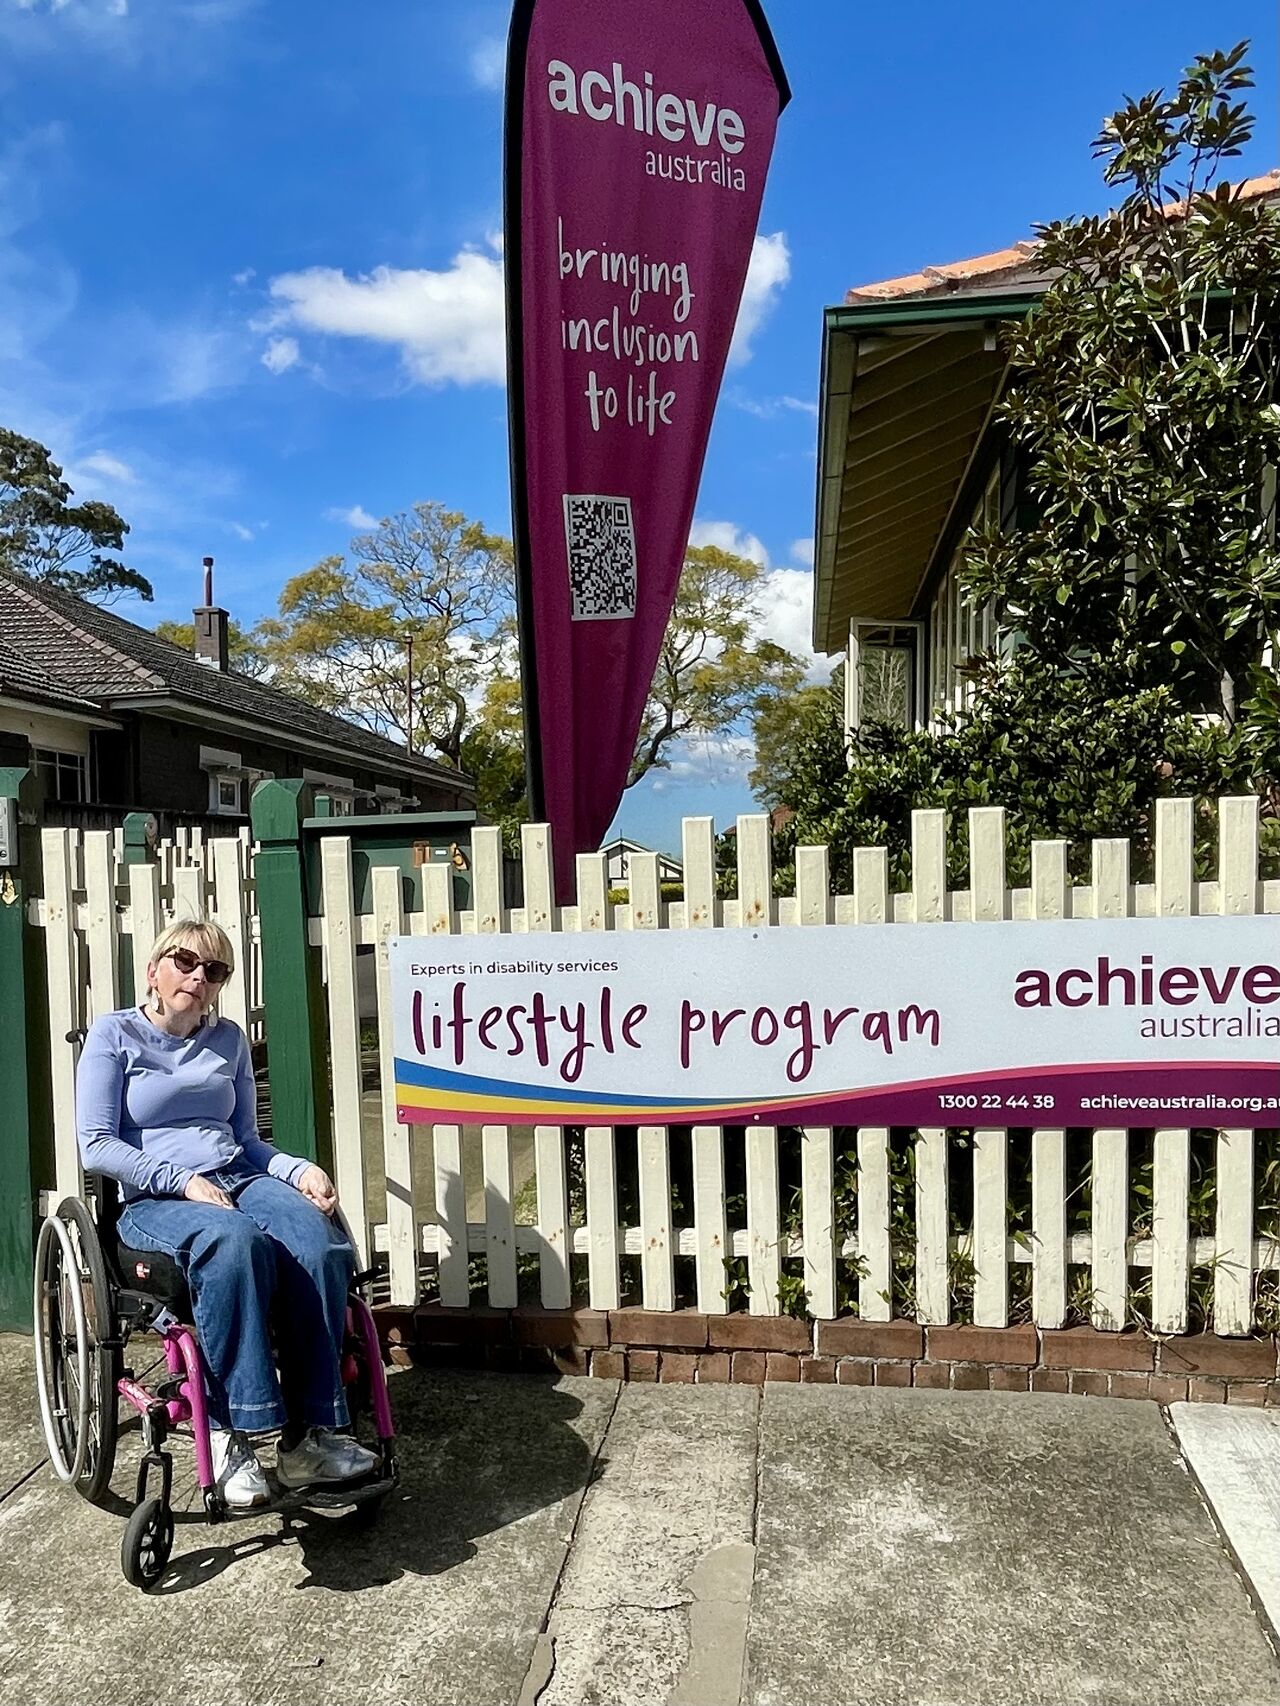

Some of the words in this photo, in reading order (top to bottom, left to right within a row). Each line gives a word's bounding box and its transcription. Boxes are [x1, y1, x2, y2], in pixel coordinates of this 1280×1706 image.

[548, 59, 745, 154] achieve
[645, 150, 745, 191] australia
[557, 216, 695, 322] bringing
[561, 305, 699, 366] inclusion
[584, 370, 618, 431] to
[627, 370, 676, 436] life
[411, 963, 465, 977] Experts
[469, 962, 482, 974] in
[487, 961, 552, 975] disability
[557, 959, 619, 972] services
[1014, 955, 1280, 1007] achieve
[412, 982, 647, 1083] lifestyle
[680, 999, 940, 1082] program
[1140, 1007, 1280, 1038] australia
[938, 1094, 977, 1109] 1300
[981, 1094, 1002, 1109] 22
[1005, 1094, 1029, 1109] 44
[1033, 1094, 1055, 1109] 38
[1080, 1094, 1280, 1111] achieveaustralia.org.a
